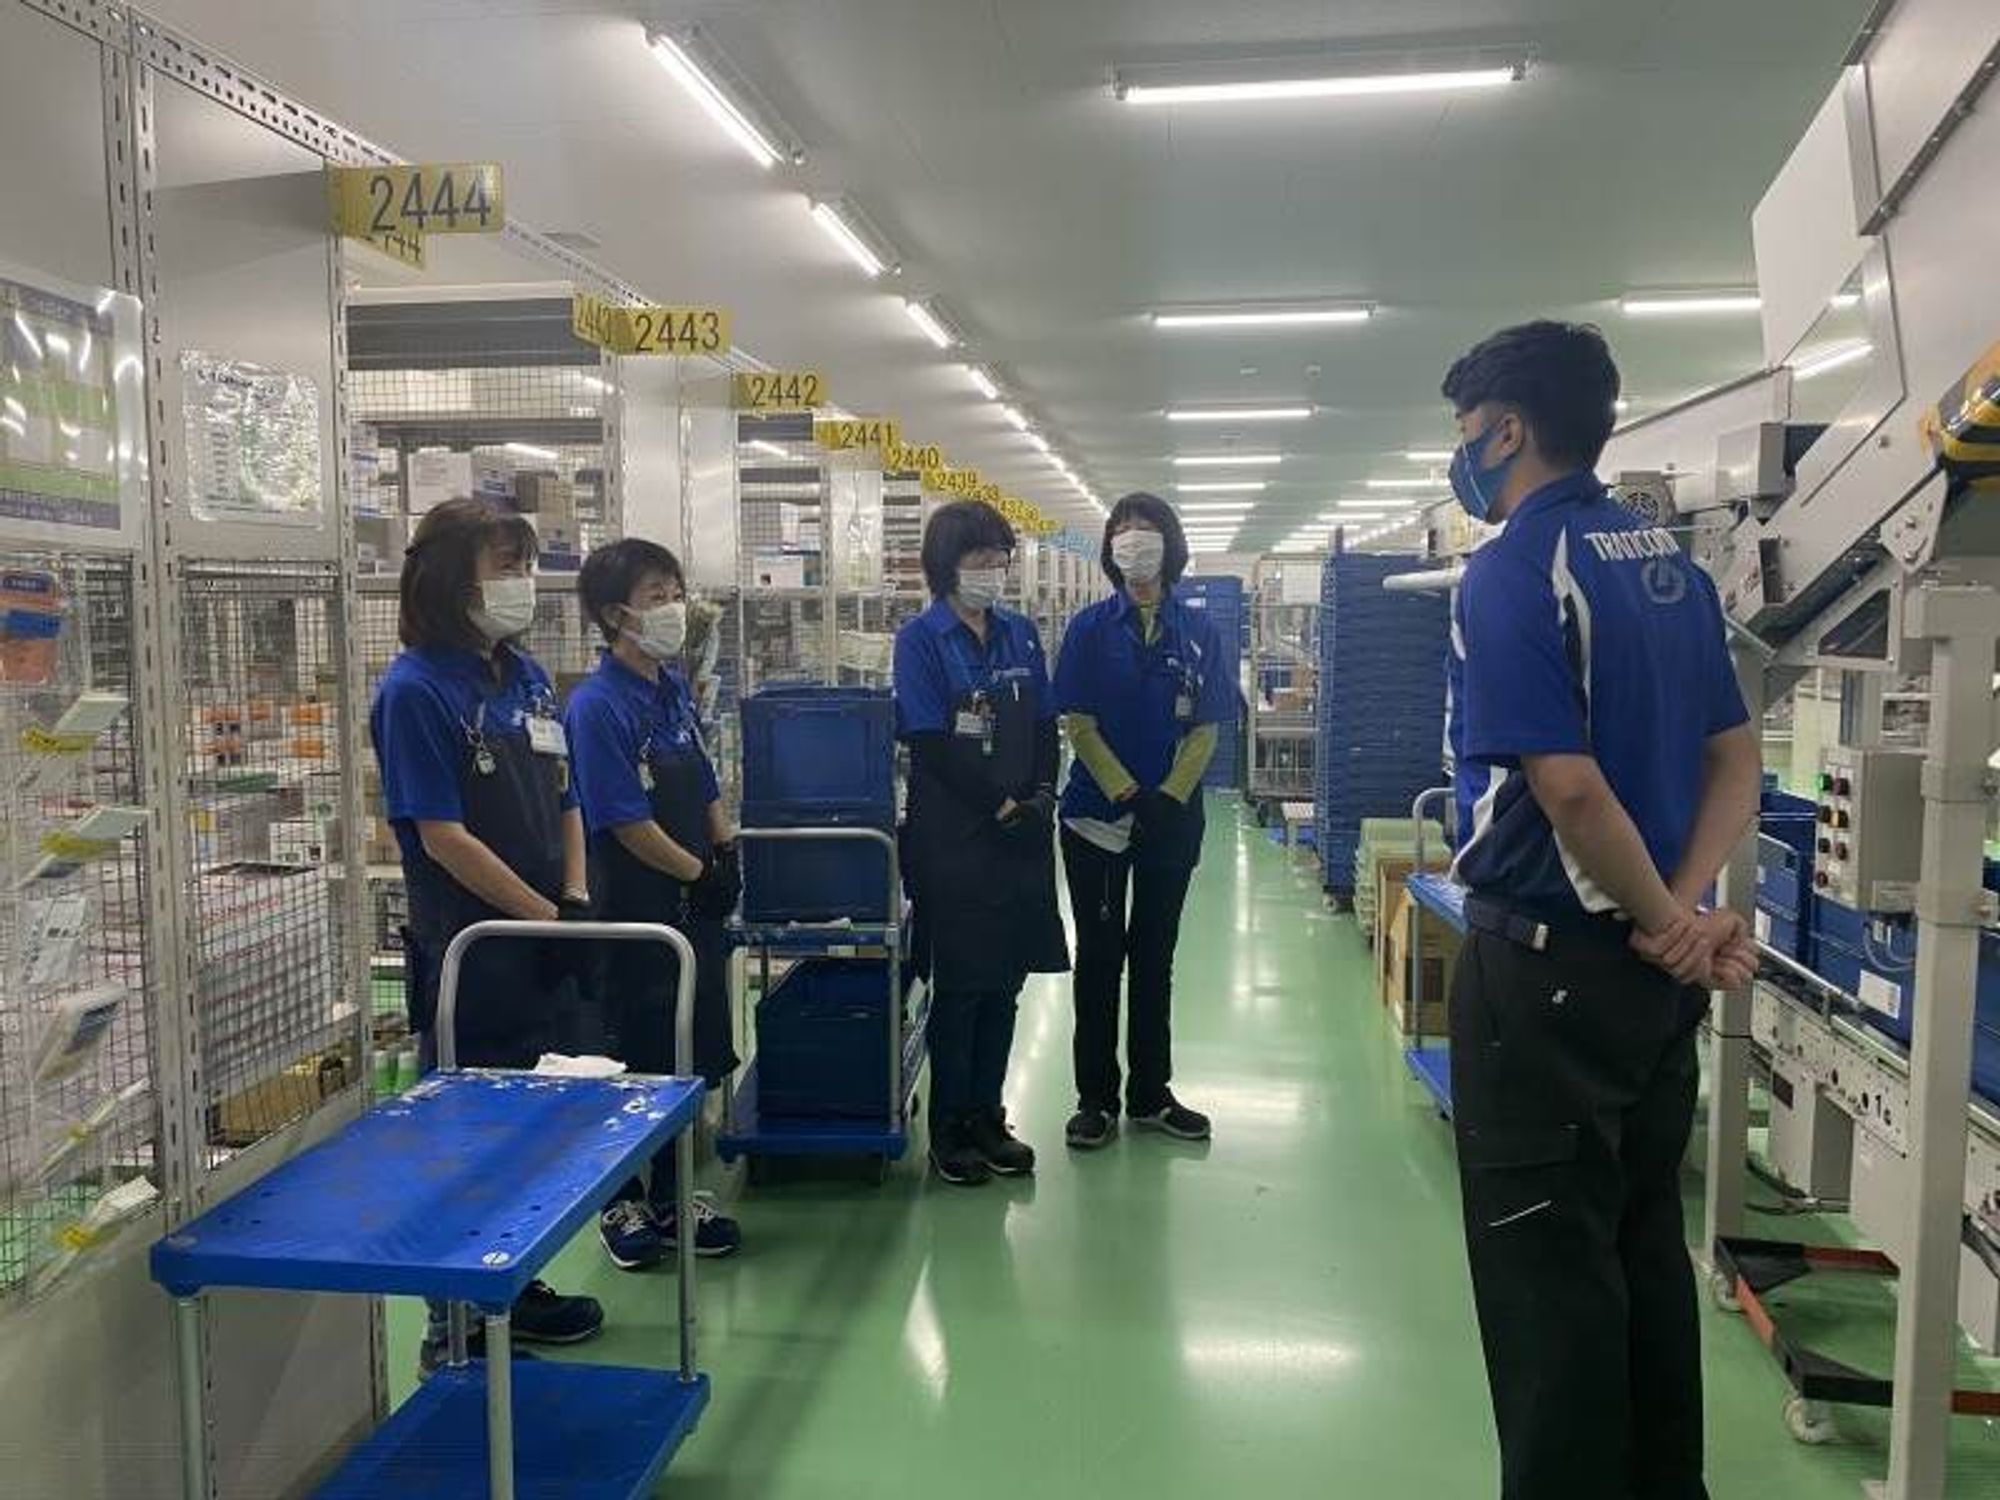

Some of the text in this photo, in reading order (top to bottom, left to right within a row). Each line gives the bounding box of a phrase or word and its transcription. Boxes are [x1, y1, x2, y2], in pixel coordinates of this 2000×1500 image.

[370, 169, 491, 231] 2444
[635, 311, 720, 352] 2443
[752, 374, 818, 407] 2442
[841, 423, 892, 448] 2441
[892, 447, 939, 469] 2440
